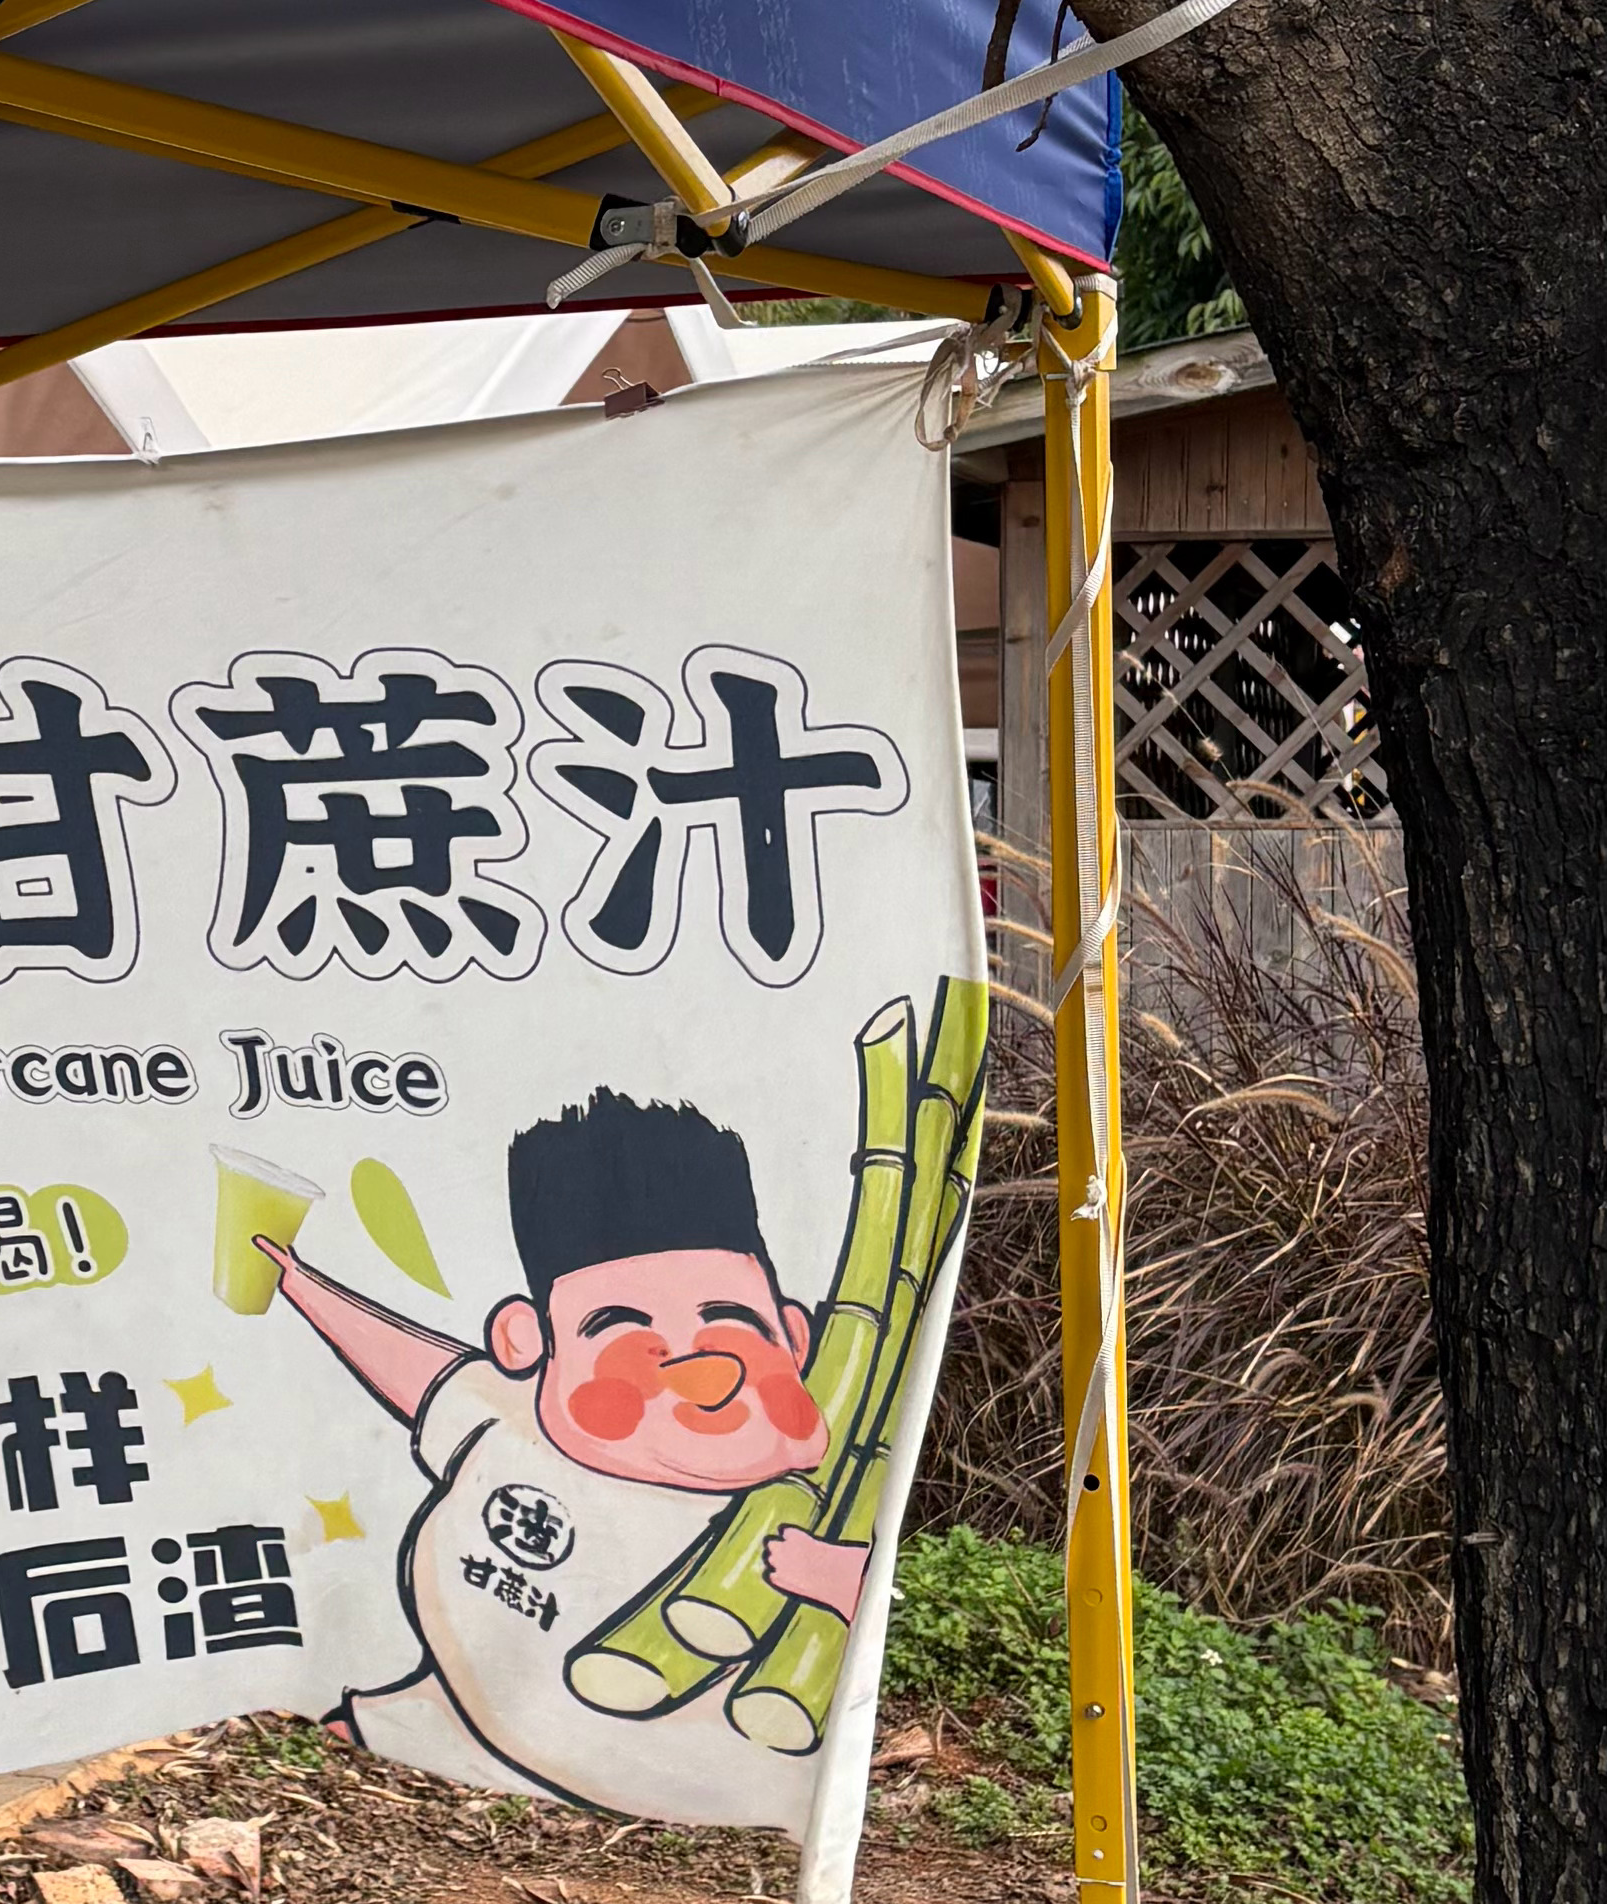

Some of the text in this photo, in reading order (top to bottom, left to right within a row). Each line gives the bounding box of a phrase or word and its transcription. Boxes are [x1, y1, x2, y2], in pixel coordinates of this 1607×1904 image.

[229, 1036, 441, 1112] Juice
[459, 1554, 560, 1632] 甘蔗汁
